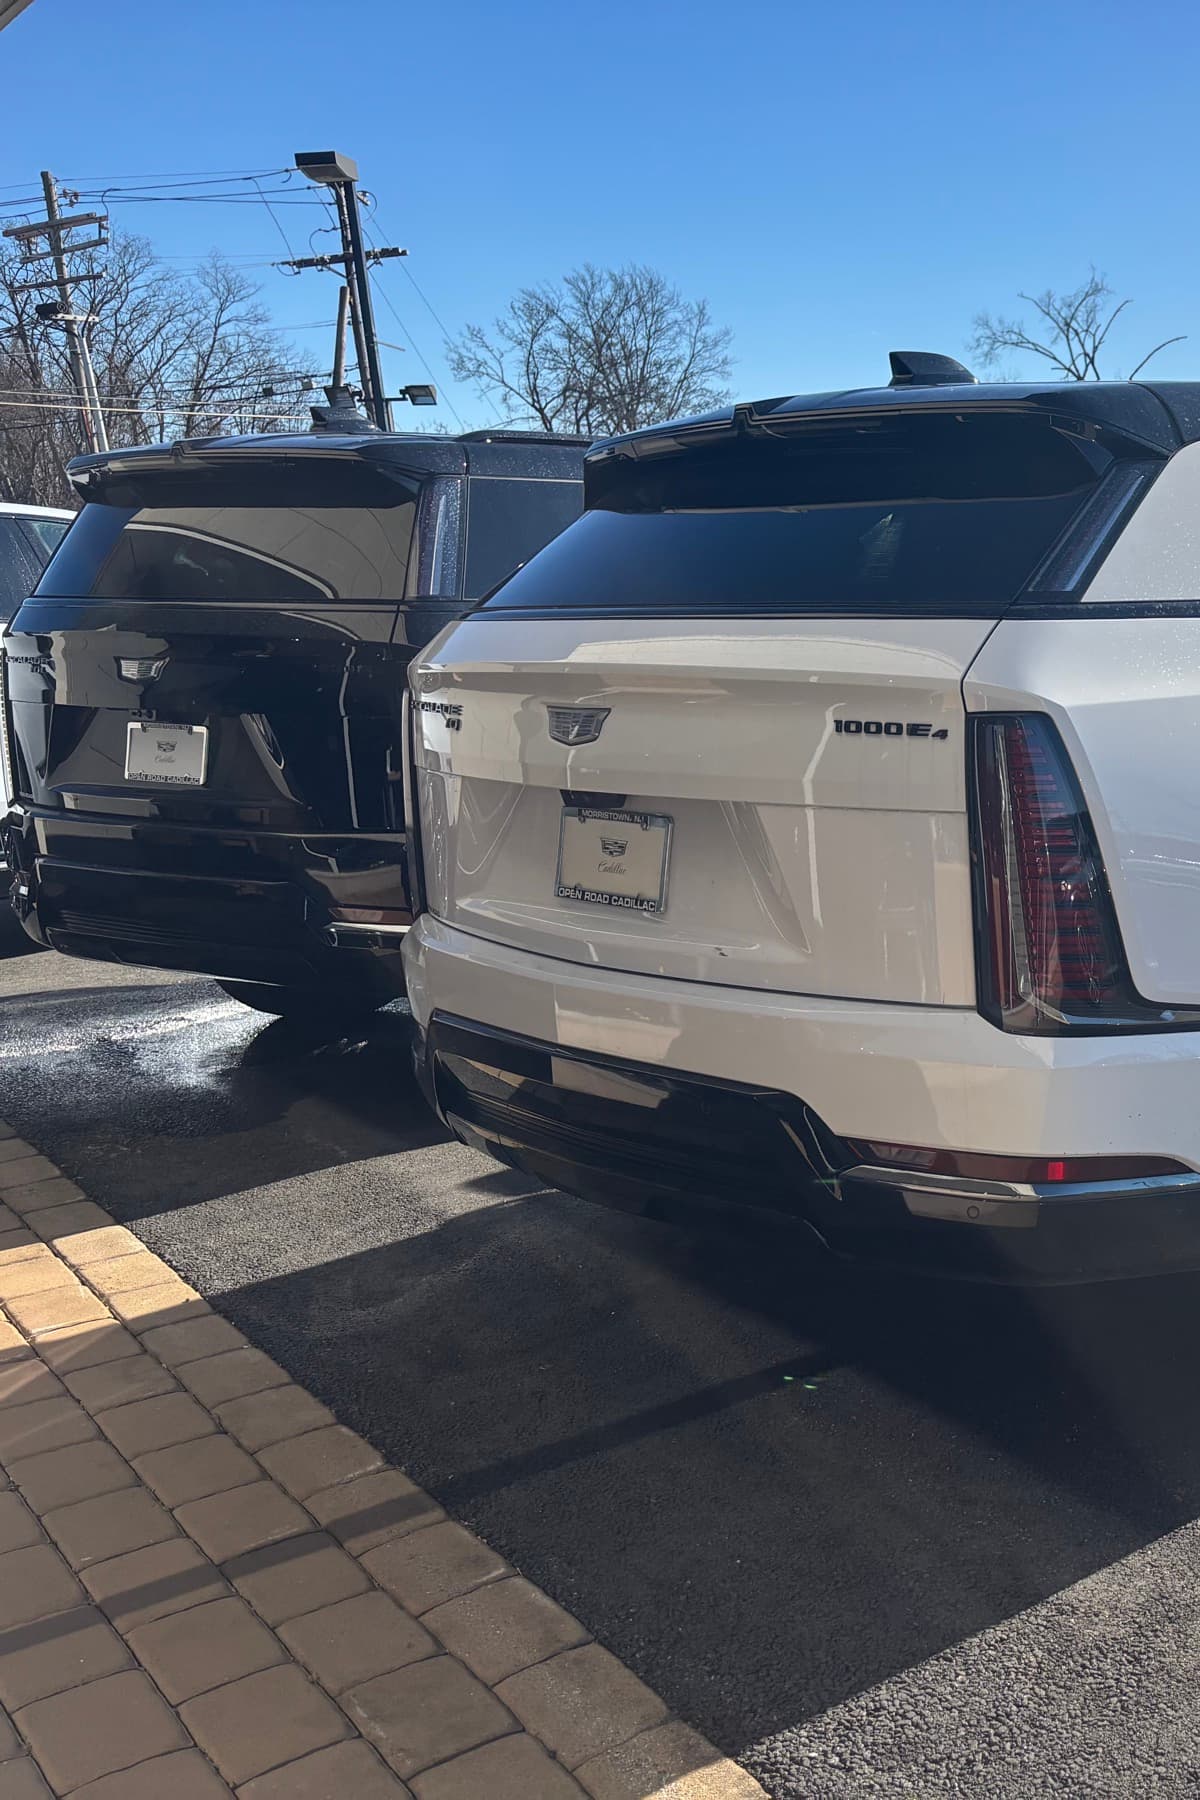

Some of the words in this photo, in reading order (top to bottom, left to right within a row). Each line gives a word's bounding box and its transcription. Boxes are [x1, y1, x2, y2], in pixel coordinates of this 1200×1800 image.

[834, 720, 949, 740] 1000E4
[558, 887, 583, 899] OPEN
[584, 892, 610, 904] ROAD
[611, 897, 656, 911] CADILLAC
